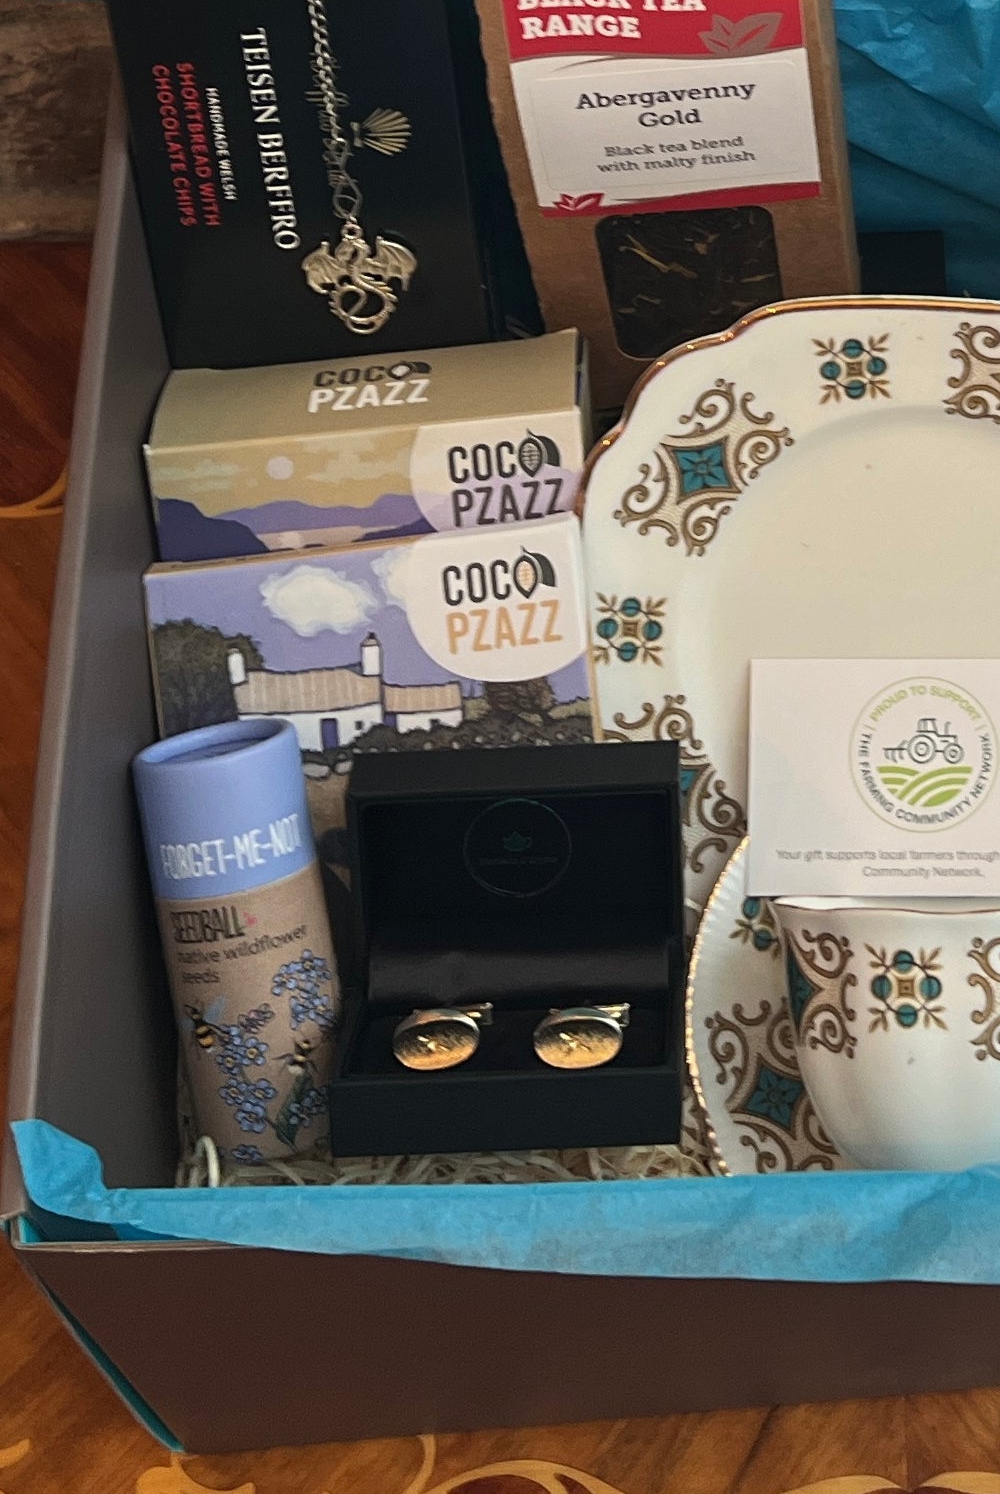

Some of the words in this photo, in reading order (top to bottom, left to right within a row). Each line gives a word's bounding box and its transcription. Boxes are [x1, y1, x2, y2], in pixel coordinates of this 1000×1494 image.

[521, 14, 641, 40] RANGE
[240, 27, 281, 124] TEISEN
[576, 82, 755, 110] Abergavenny
[638, 109, 702, 128] Gold
[152, 64, 189, 173] CHOCOLATE
[173, 177, 199, 227] CHIPS
[176, 62, 213, 179] SHORTBREAD
[199, 183, 222, 226] WITH
[206, 87, 230, 157] HANDMADE
[218, 159, 238, 201] WELSH
[598, 160, 639, 174] with
[645, 155, 697, 174] malty
[700, 149, 755, 166] finish
[604, 142, 654, 158] Black
[659, 142, 689, 155] tea
[694, 136, 744, 153] blend
[257, 133, 301, 250] BERFFRO
[308, 378, 430, 413] PZAZZ
[451, 478, 566, 527] PZAZZ
[445, 599, 563, 655] PZAZZ
[868, 689, 908, 722] PROUD
[909, 685, 927, 696] TO
[930, 685, 982, 721] SUPPORT
[858, 733, 872, 757] THE
[969, 732, 993, 799] NETWORK
[859, 761, 895, 813] FARMING
[894, 796, 973, 825] COMMUNITY
[160, 813, 300, 880] FORGET-ME-NOT
[775, 849, 801, 860] Your
[804, 849, 822, 862] gift
[825, 851, 876, 861] supports
[878, 849, 907, 860] local
[909, 849, 954, 860] farmers
[956, 850, 1000, 863] through
[863, 865, 929, 879] Community
[178, 949, 221, 964] native
[222, 924, 308, 961] wildflower
